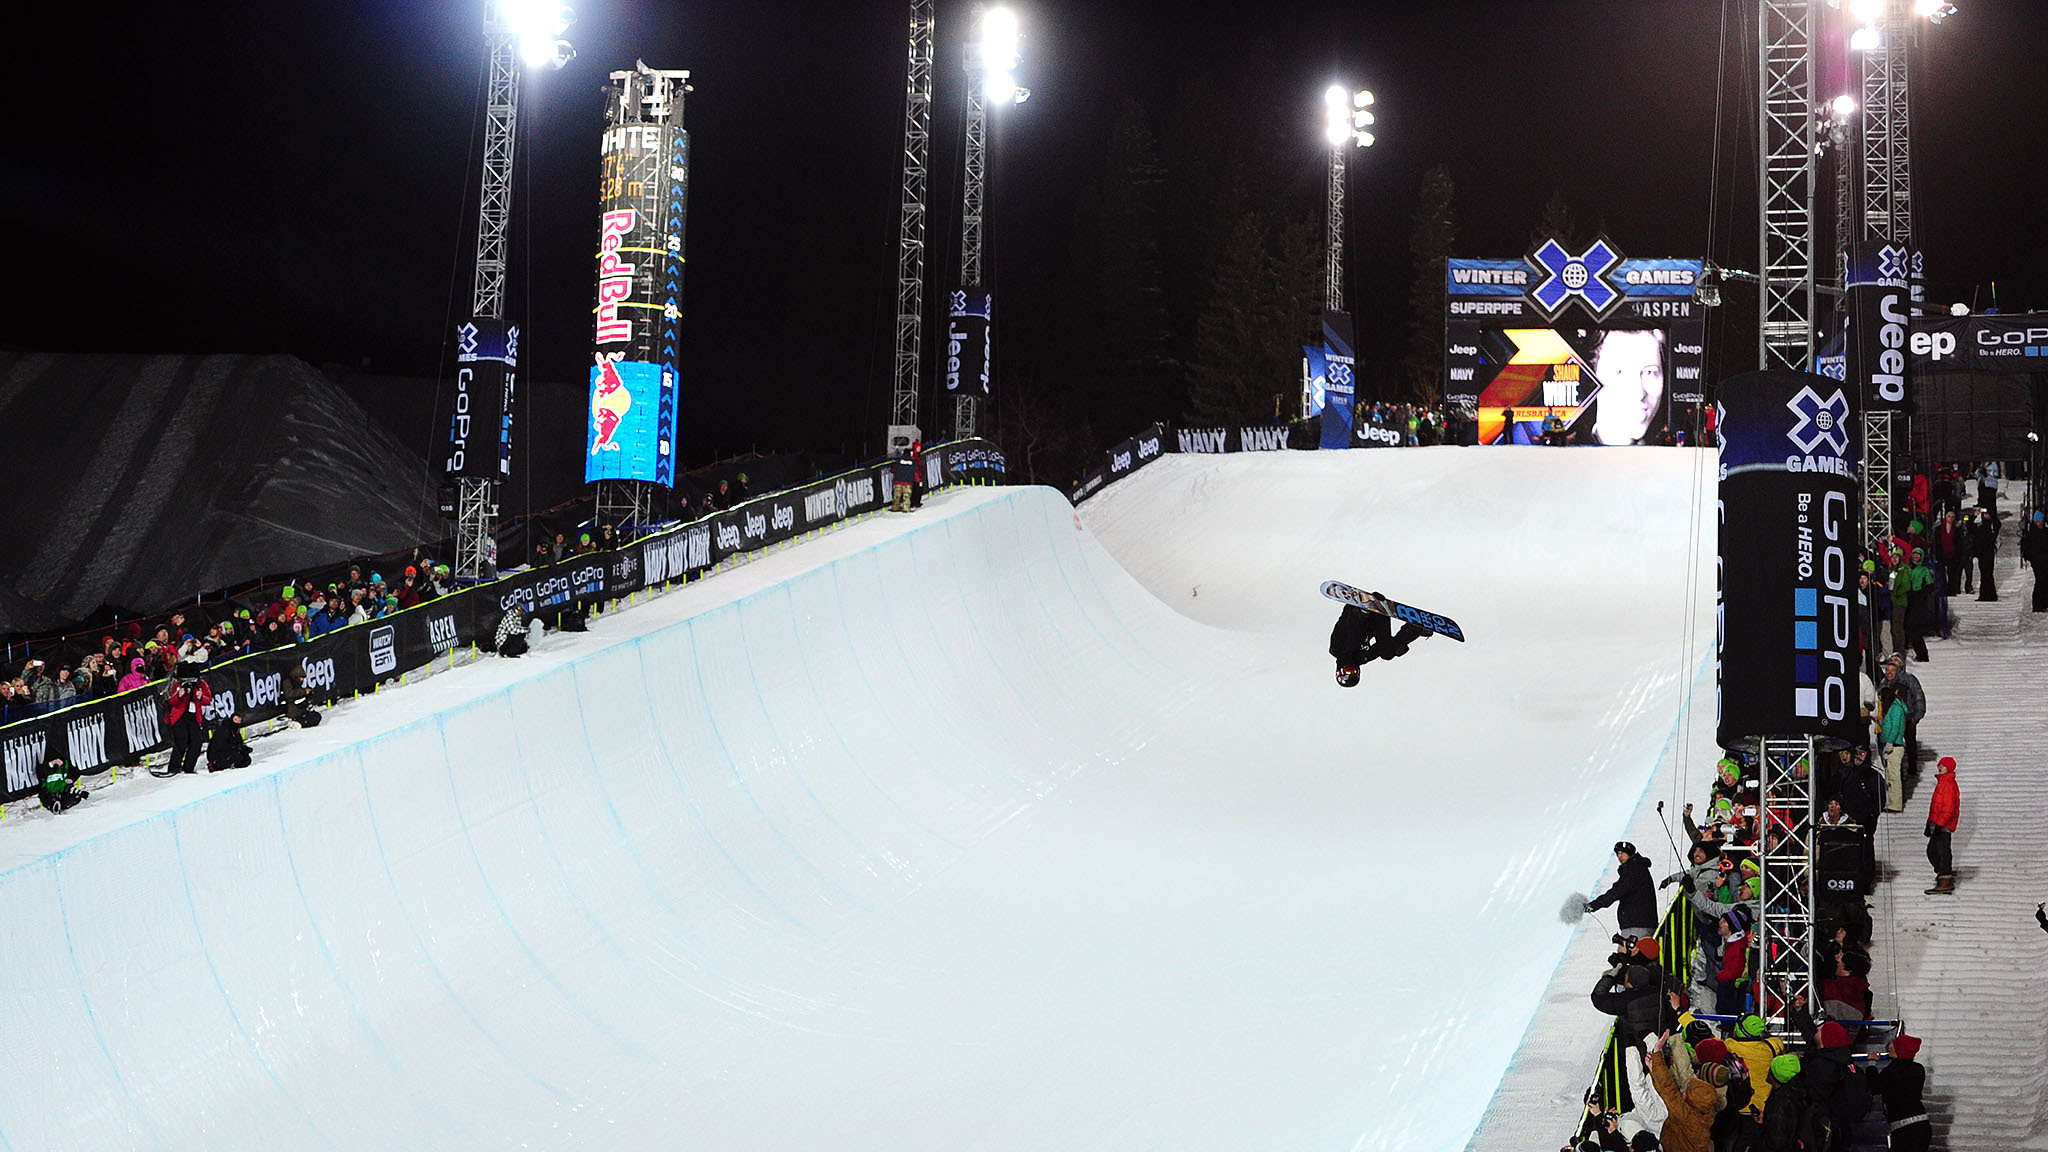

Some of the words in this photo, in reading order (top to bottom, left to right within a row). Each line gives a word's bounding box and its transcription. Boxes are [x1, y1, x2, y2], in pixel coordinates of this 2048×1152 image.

[600, 209, 635, 278] Red
[1453, 269, 1528, 284] WINTER
[1626, 269, 1694, 284] GAMES
[596, 279, 633, 345] Bull
[1450, 303, 1522, 315] SUPERPIPE
[1643, 302, 1690, 317] ASPEN
[1872, 294, 1908, 402] Jeep
[1910, 331, 1956, 361] ep
[1977, 328, 2048, 345] GoP
[1449, 344, 1478, 356] Jeep
[1674, 343, 1703, 355] Jeep
[1450, 367, 1475, 381] NAVY
[1676, 366, 1700, 380] NAVY
[1542, 380, 1580, 407] WHITE
[452, 367, 474, 472] GoPro
[1241, 430, 1290, 452] NAVY
[1357, 422, 1401, 446] Jeep
[1137, 437, 1160, 459] Jeep
[1111, 450, 1131, 473] Jeep
[804, 488, 836, 523] WINTER
[846, 476, 874, 509] GAMES
[1798, 492, 1812, 512] Be
[717, 520, 741, 550] Jeep
[744, 511, 766, 539] Jeep
[771, 503, 794, 531] Jeep
[1798, 514, 1808, 523] a
[1798, 525, 1813, 582] HERO.
[500, 587, 534, 611] GoPro
[536, 577, 569, 597] GoPro
[571, 566, 604, 586] GoPro
[1823, 490, 1850, 722] GoPro
[429, 614, 457, 644] ASPEN
[245, 671, 281, 709] Jeep
[202, 690, 235, 721] eep
[1827, 879, 1854, 890] OSA
